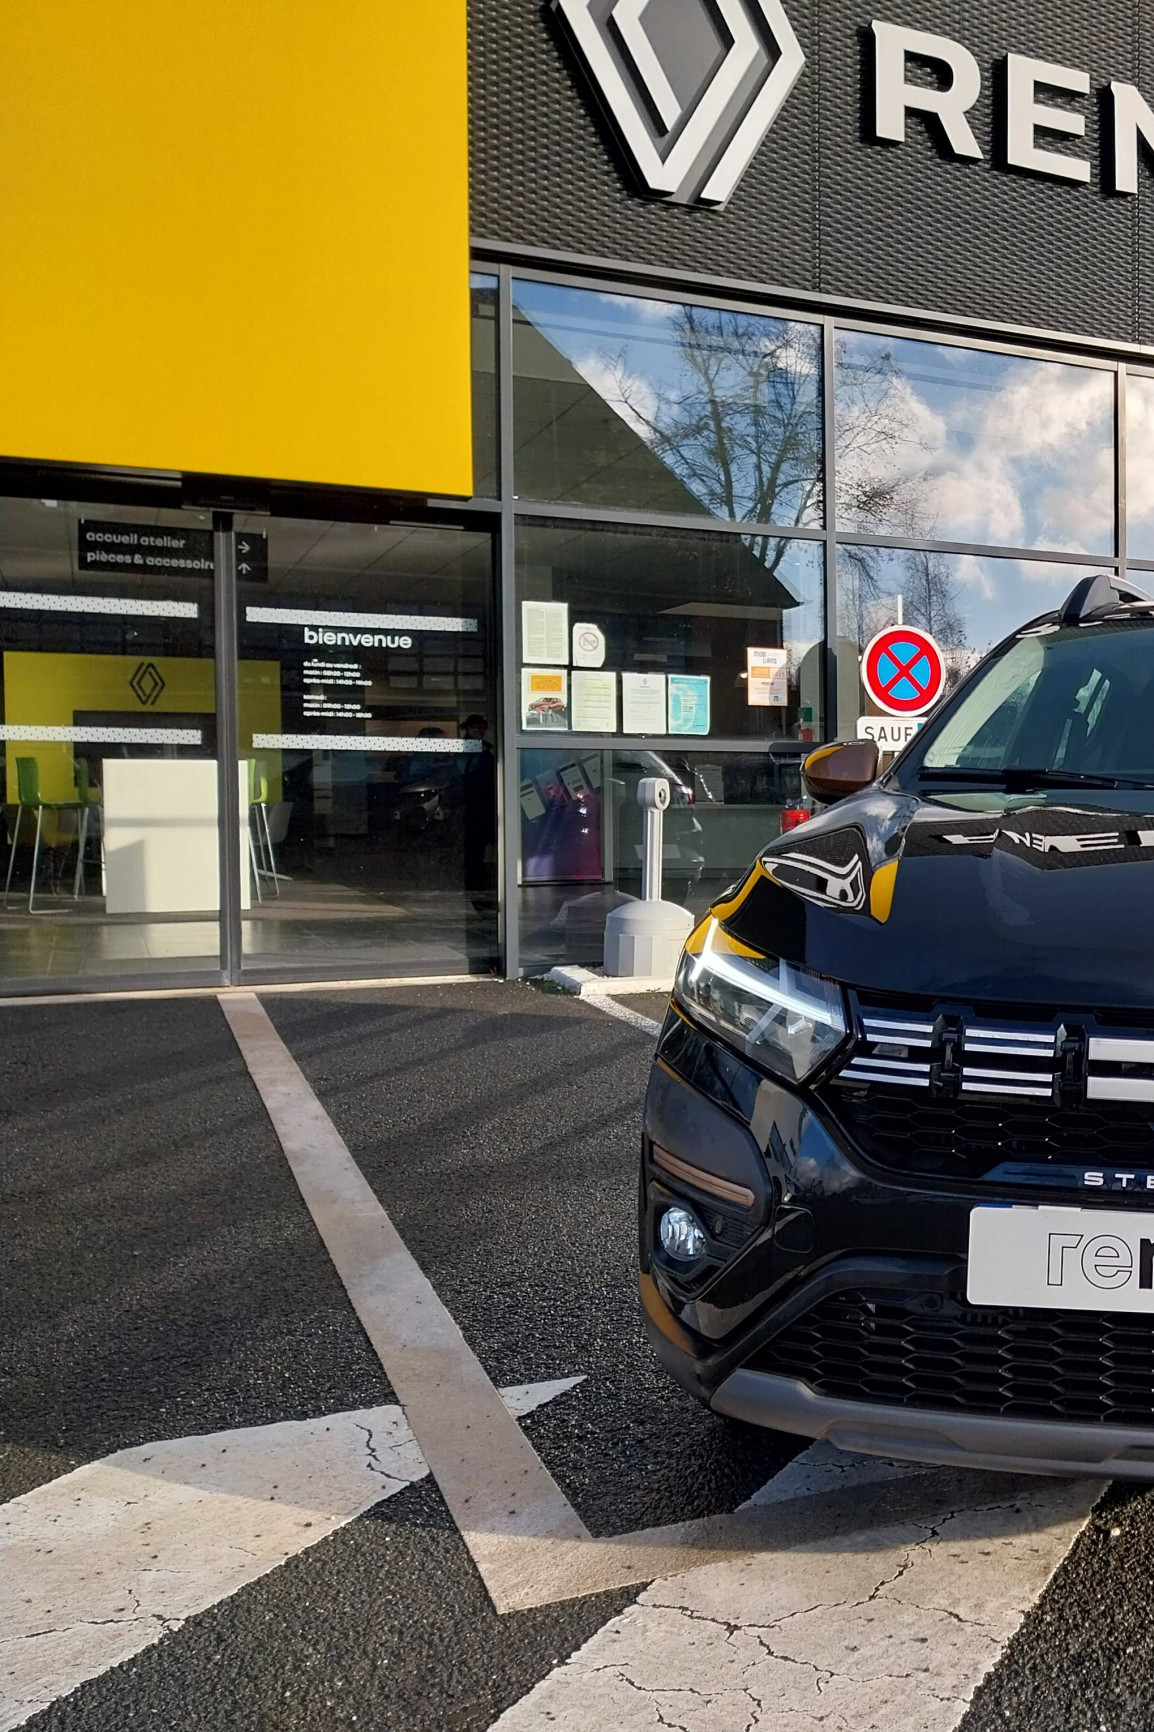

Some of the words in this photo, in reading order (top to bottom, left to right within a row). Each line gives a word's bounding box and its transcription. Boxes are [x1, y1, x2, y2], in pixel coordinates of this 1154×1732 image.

[86, 530, 138, 545] accueil
[140, 535, 186, 549] atelier
[87, 550, 132, 564] pièces
[133, 554, 144, 565] &
[303, 627, 412, 649] bienvenue
[864, 725, 913, 743] SAUF
